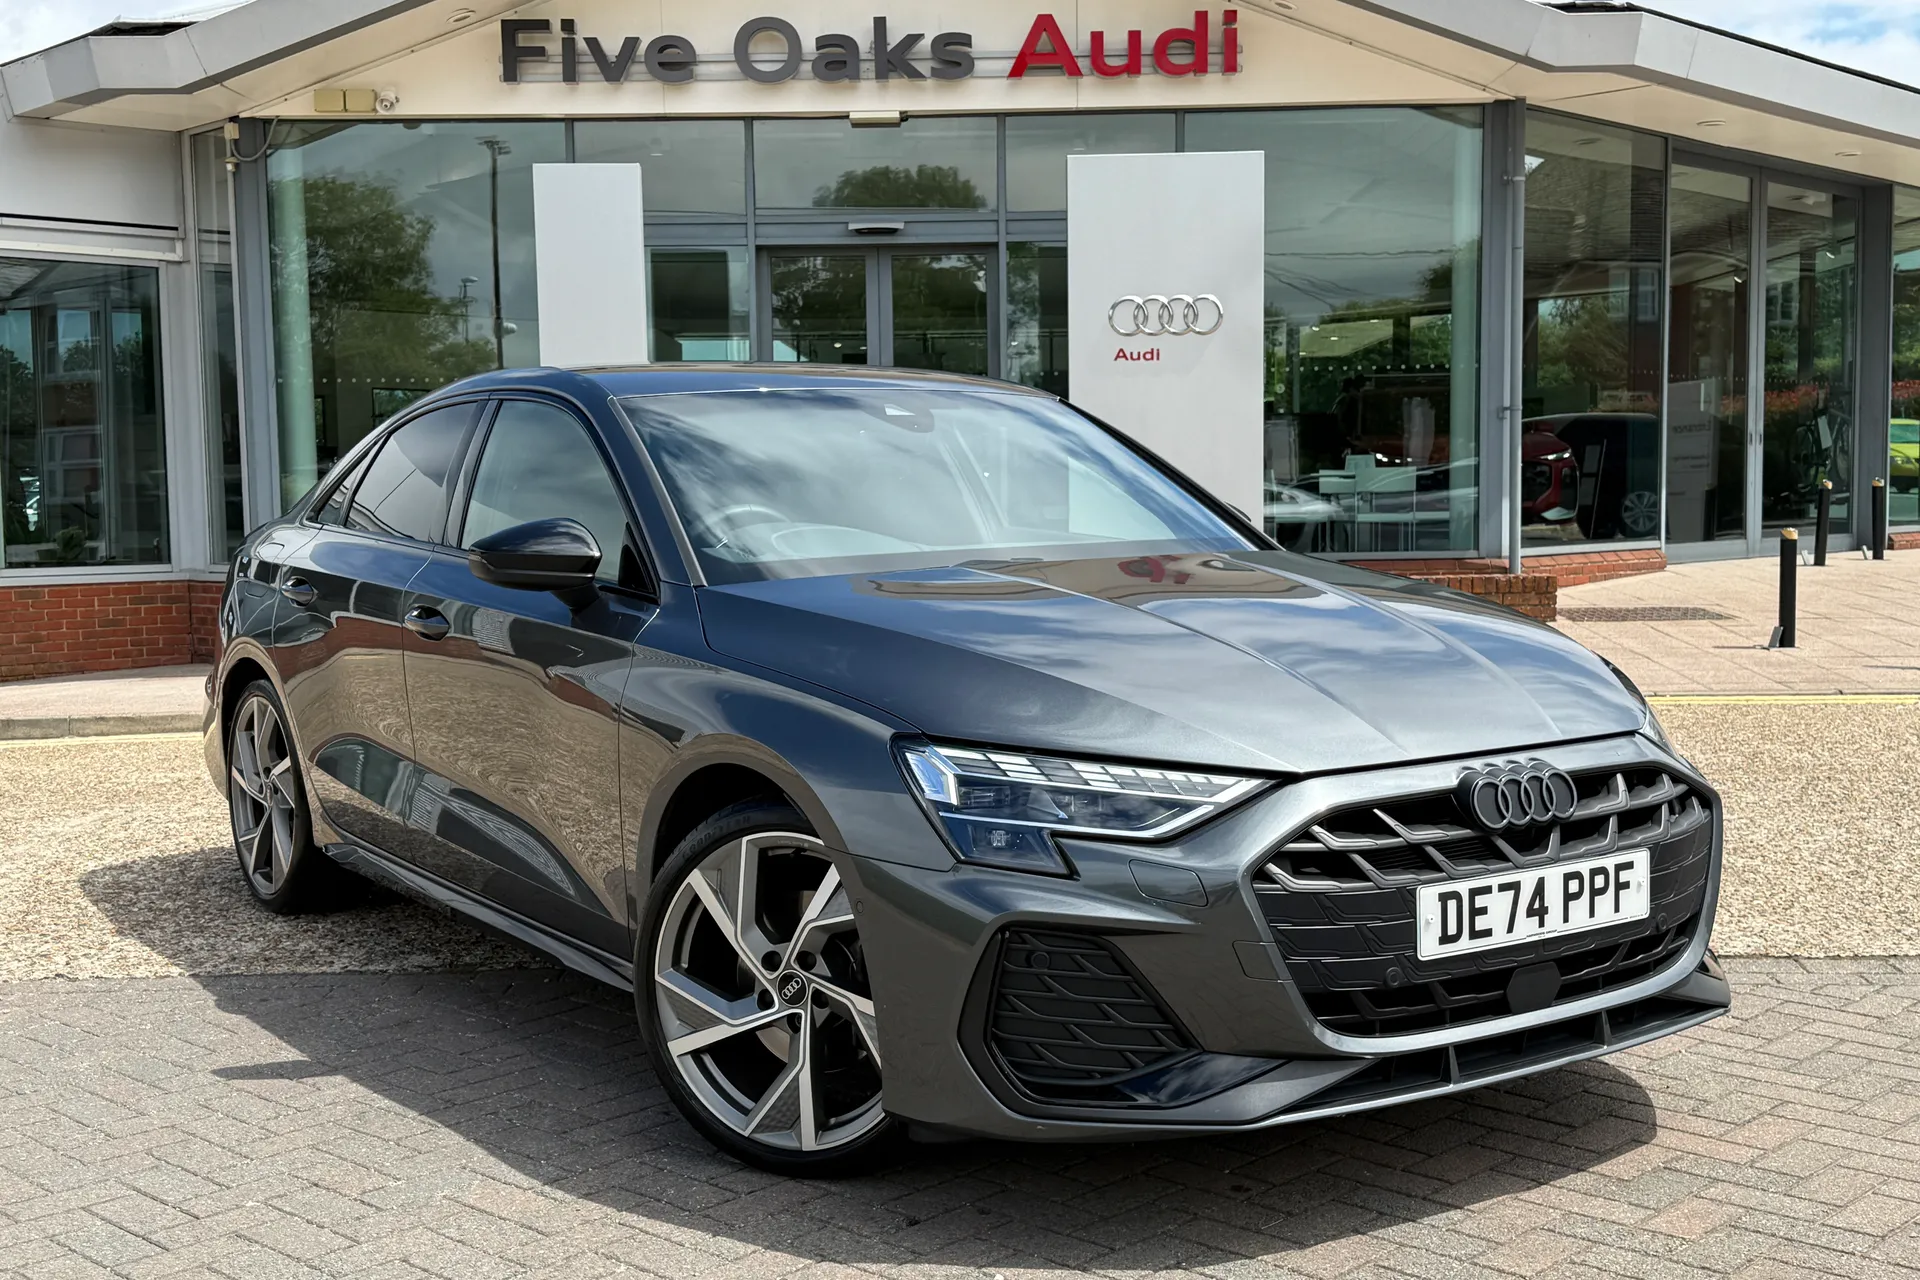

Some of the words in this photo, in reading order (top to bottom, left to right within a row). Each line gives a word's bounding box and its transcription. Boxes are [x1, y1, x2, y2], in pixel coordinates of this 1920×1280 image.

[500, 18, 697, 84] Five
[733, 16, 975, 84] Oaks
[1007, 9, 1238, 79] Audi
[1113, 347, 1160, 361] Audi
[1438, 876, 1549, 945] DE74
[1562, 860, 1635, 924] PPF
